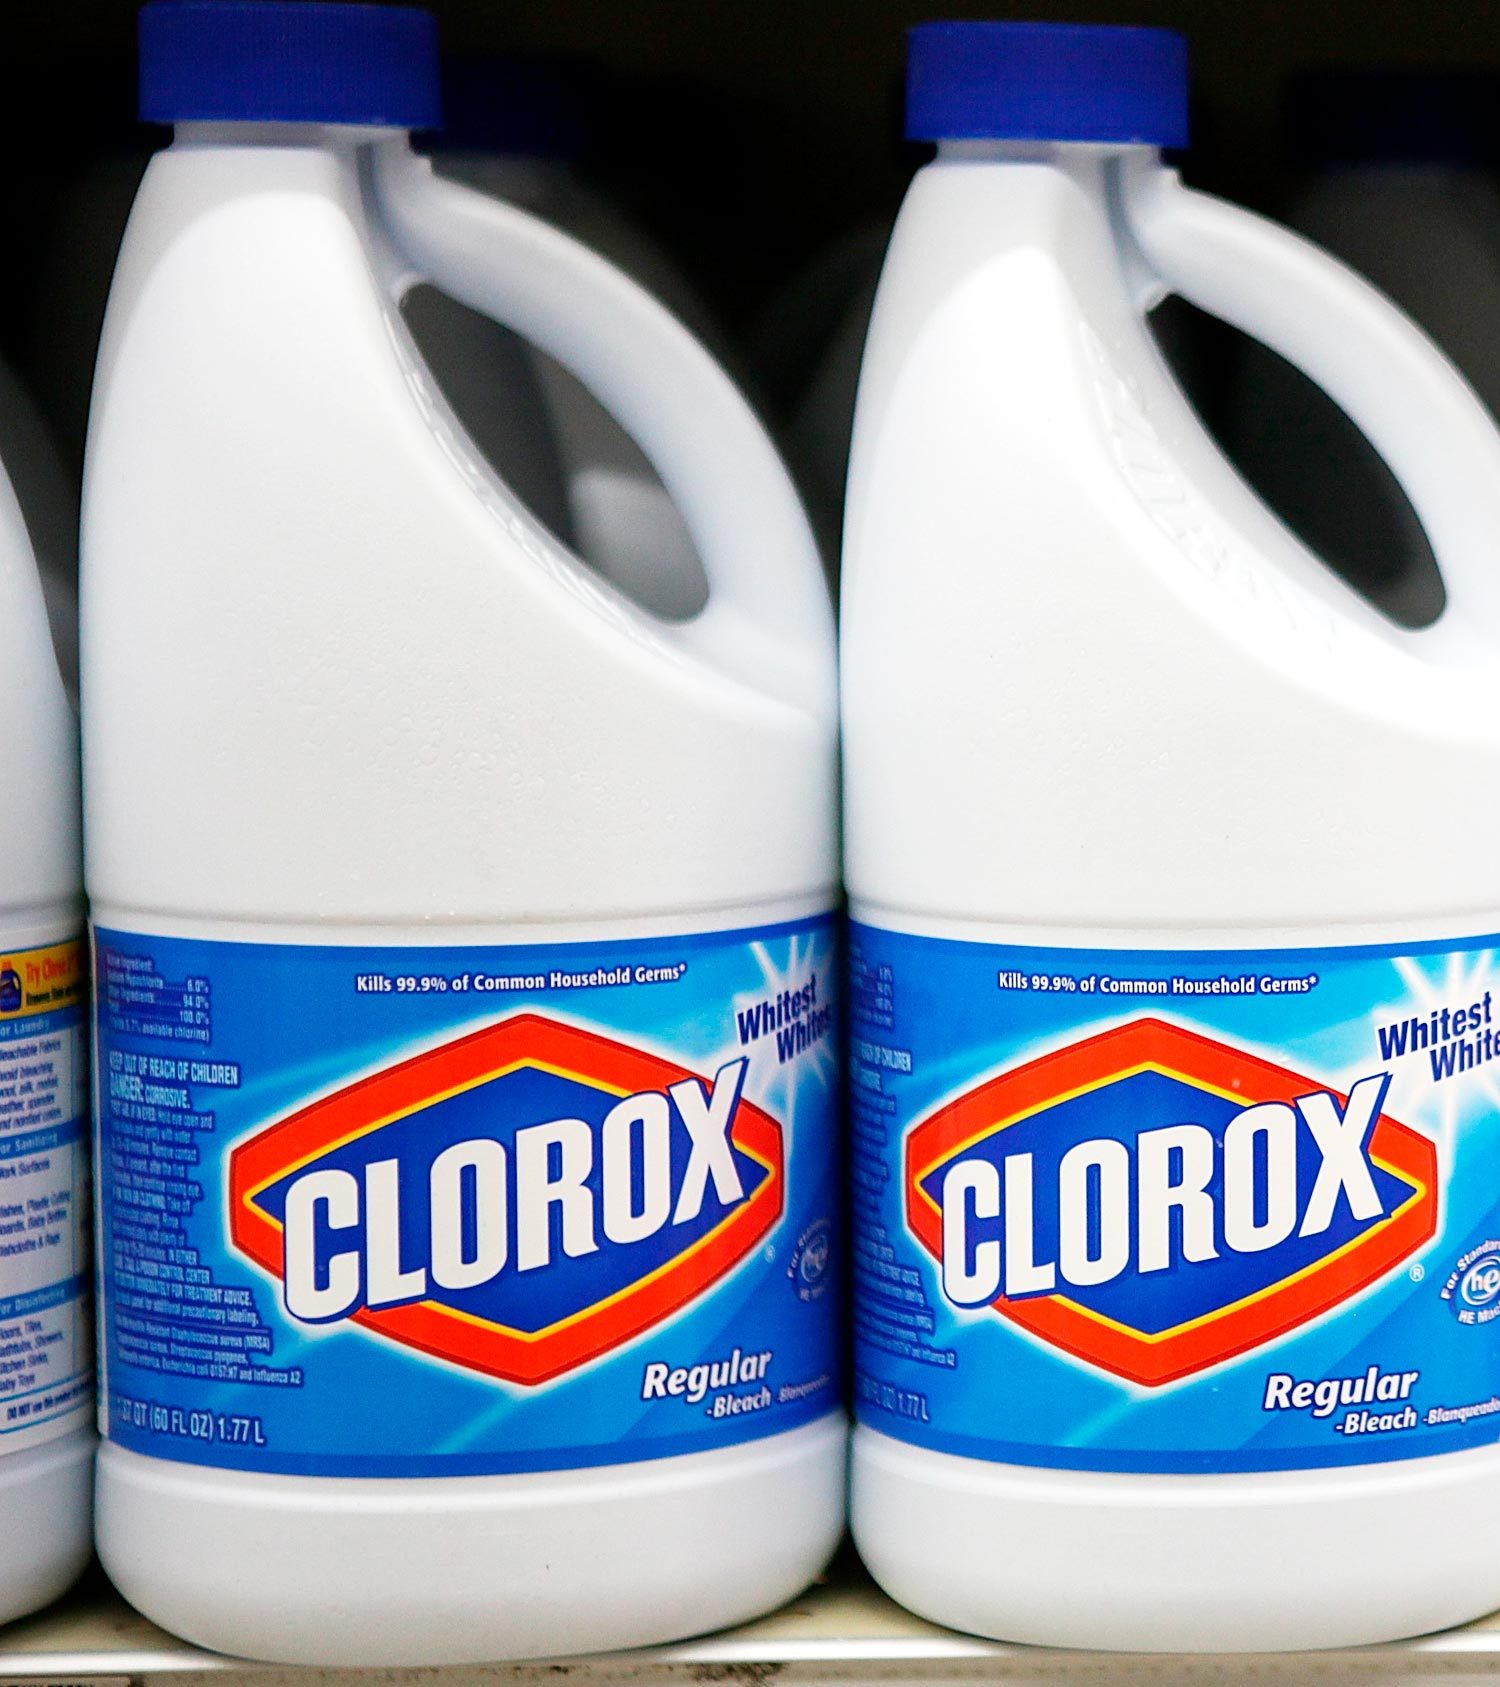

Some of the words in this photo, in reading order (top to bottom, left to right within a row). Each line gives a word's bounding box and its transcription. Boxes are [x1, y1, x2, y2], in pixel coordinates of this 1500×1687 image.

[356, 975, 392, 992] Kills
[396, 975, 447, 992] 99.9%
[451, 974, 470, 991] of
[473, 973, 545, 991] Common
[550, 966, 631, 988] Household
[998, 972, 1028, 990] Kills
[1031, 975, 1076, 992] 99.9%
[1079, 975, 1096, 992] of
[1100, 976, 1167, 994] Common
[1172, 975, 1255, 994] Household
[737, 973, 817, 1046] Whitest
[1377, 991, 1492, 1061] Whitest
[149, 1057, 176, 1080] REACH
[177, 1061, 190, 1081] OF
[190, 1061, 239, 1086] CHILDREN
[144, 1083, 191, 1110] CORROSIVE.
[283, 1058, 748, 1322] CLOROX
[942, 1073, 1392, 1308] CLOROX
[223, 1289, 253, 1307] ADVICE.
[1440, 1272, 1460, 1299] For
[226, 1307, 259, 1328] labeling.
[1458, 1310, 1476, 1324] HE
[243, 1334, 271, 1351] (MRSA)
[239, 1367, 252, 1379] and
[252, 1368, 289, 1384] Influenza
[289, 1370, 302, 1385] A2
[642, 1348, 772, 1404] Regular
[1263, 1365, 1419, 1417] Regular
[133, 1403, 148, 1426] QT
[150, 1405, 169, 1431] (60
[171, 1409, 188, 1435] FL
[189, 1411, 214, 1441] OZ)
[217, 1416, 250, 1444] 1.77
[253, 1421, 266, 1444] L
